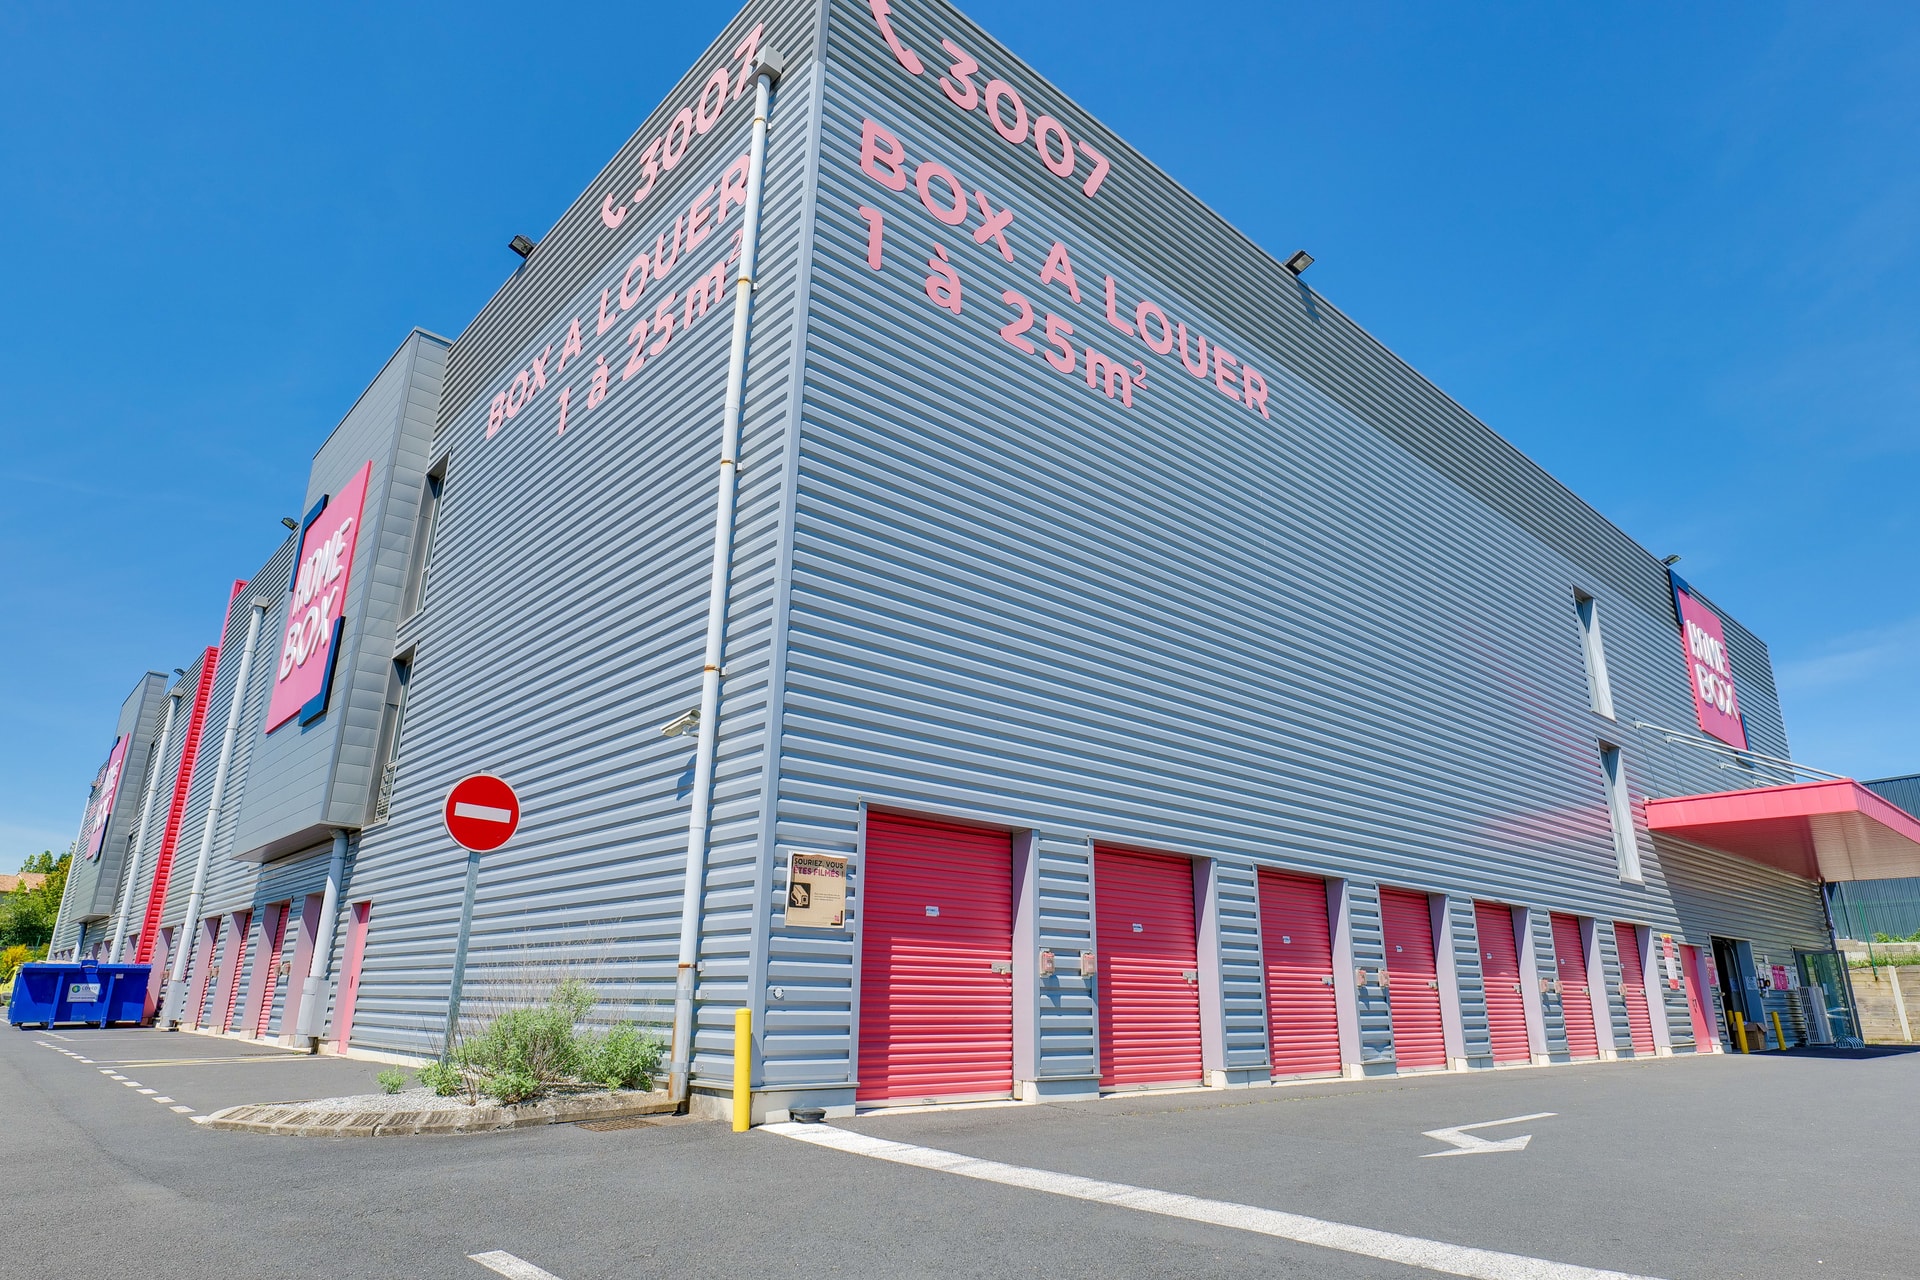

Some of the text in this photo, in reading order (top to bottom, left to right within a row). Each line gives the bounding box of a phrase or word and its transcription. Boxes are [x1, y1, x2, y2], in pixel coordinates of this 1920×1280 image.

[634, 23, 763, 203] 3007
[940, 39, 1110, 197] 3007
[486, 154, 750, 440] BOX A LOUER
[858, 206, 884, 271] 1
[925, 243, 962, 315] à
[860, 118, 1270, 420] BOX A LOUER
[557, 387, 571, 436] 1
[587, 355, 608, 410] à
[292, 517, 354, 617] HOME
[279, 586, 339, 682] BOX
[1685, 618, 1730, 678] HOME
[1695, 664, 1739, 720] BOX
[813, 868, 840, 878] FILMÉS
